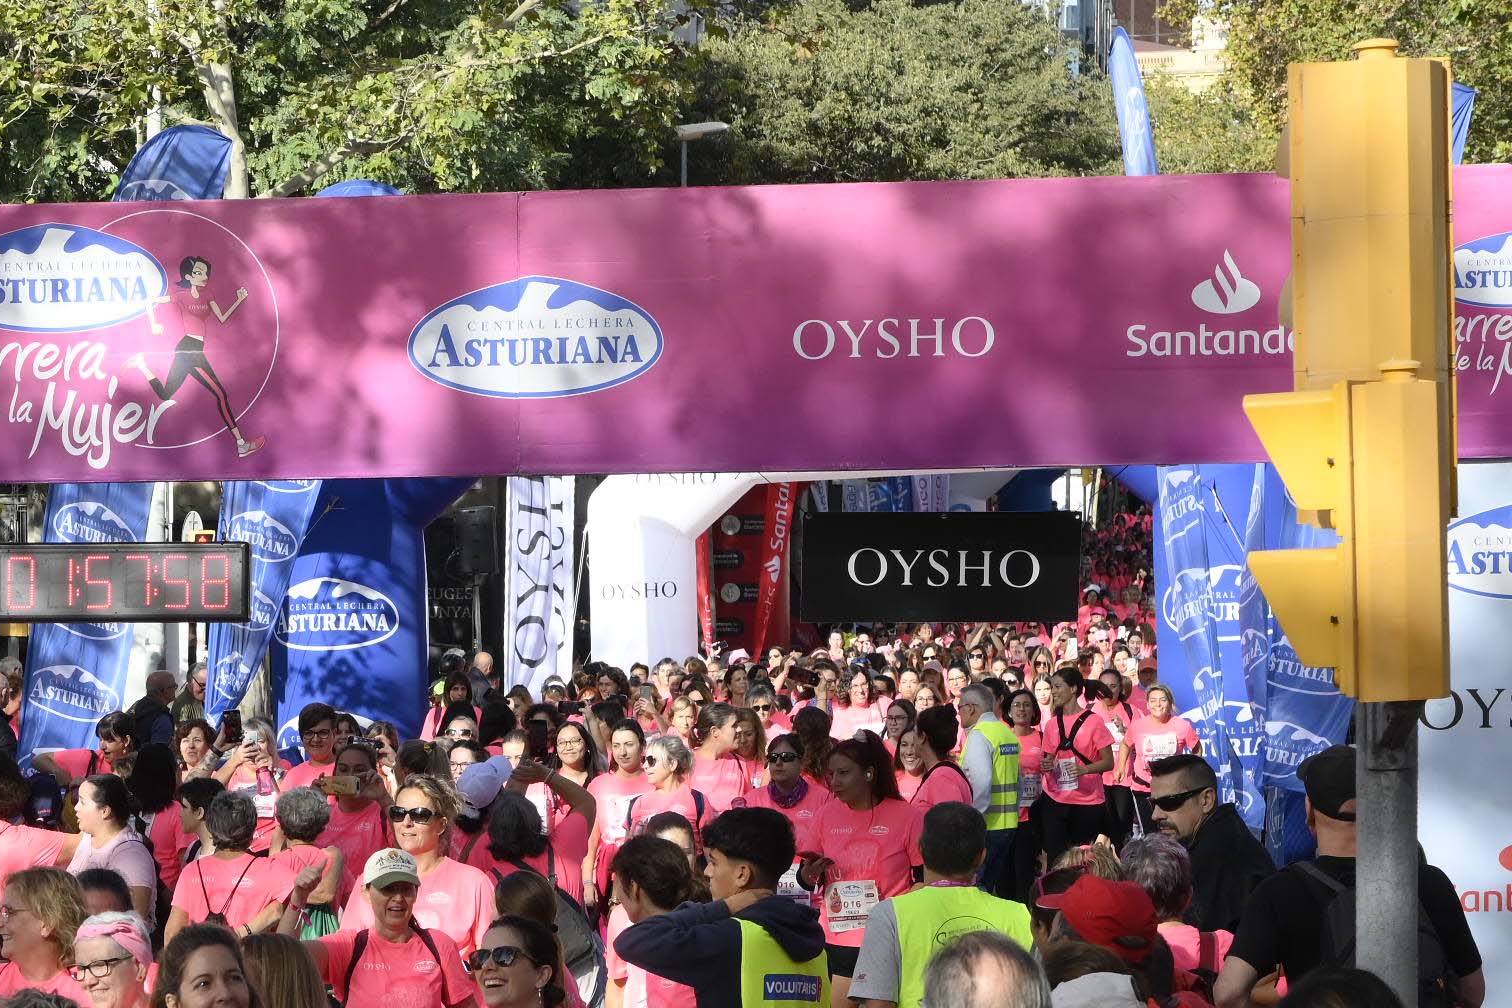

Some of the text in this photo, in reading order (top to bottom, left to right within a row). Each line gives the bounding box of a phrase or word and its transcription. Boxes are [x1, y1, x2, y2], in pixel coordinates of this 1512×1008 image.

[69, 260, 143, 271] LECHERA
[466, 316, 636, 332] CENTRAL LECHERA
[792, 316, 996, 360] OYSHO
[1126, 323, 1294, 358] Santand
[428, 323, 644, 368] ASTURIANA
[8, 384, 33, 423] la
[28, 375, 176, 469] Mujer
[771, 481, 791, 552] Santa
[7, 555, 230, 610] 01:57:58
[847, 547, 1041, 589] OYSHO
[290, 602, 385, 611] CENTRAL LECHERA
[601, 580, 678, 600] OYSHO
[277, 608, 390, 635] ASTURIANA
[30, 676, 111, 714] ASTURIANA
[843, 901, 862, 909] 016
